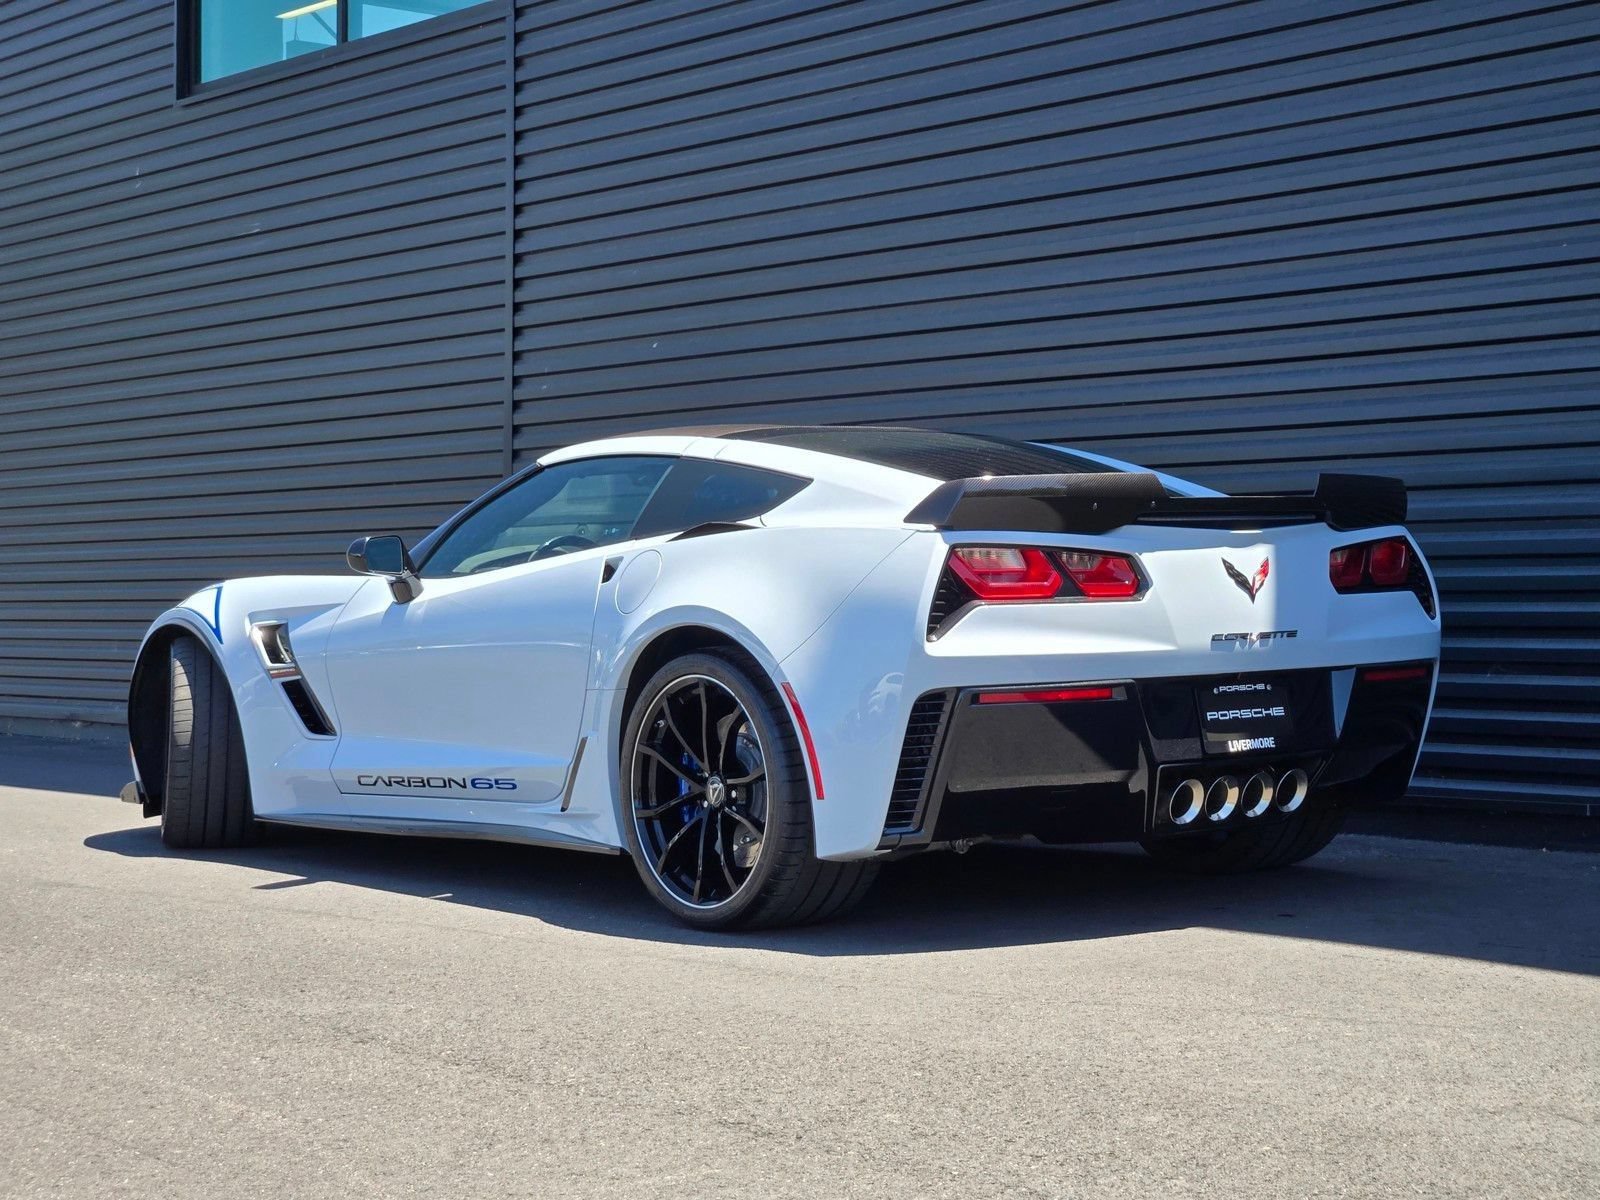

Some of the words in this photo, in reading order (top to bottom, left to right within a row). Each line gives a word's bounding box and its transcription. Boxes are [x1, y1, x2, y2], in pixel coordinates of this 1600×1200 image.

[1219, 683, 1265, 692] PORSCHE
[1206, 706, 1285, 721] PORSCHE
[1228, 737, 1275, 752] LIVERMORE
[357, 775, 467, 789] CARBON
[470, 777, 517, 790] 65
